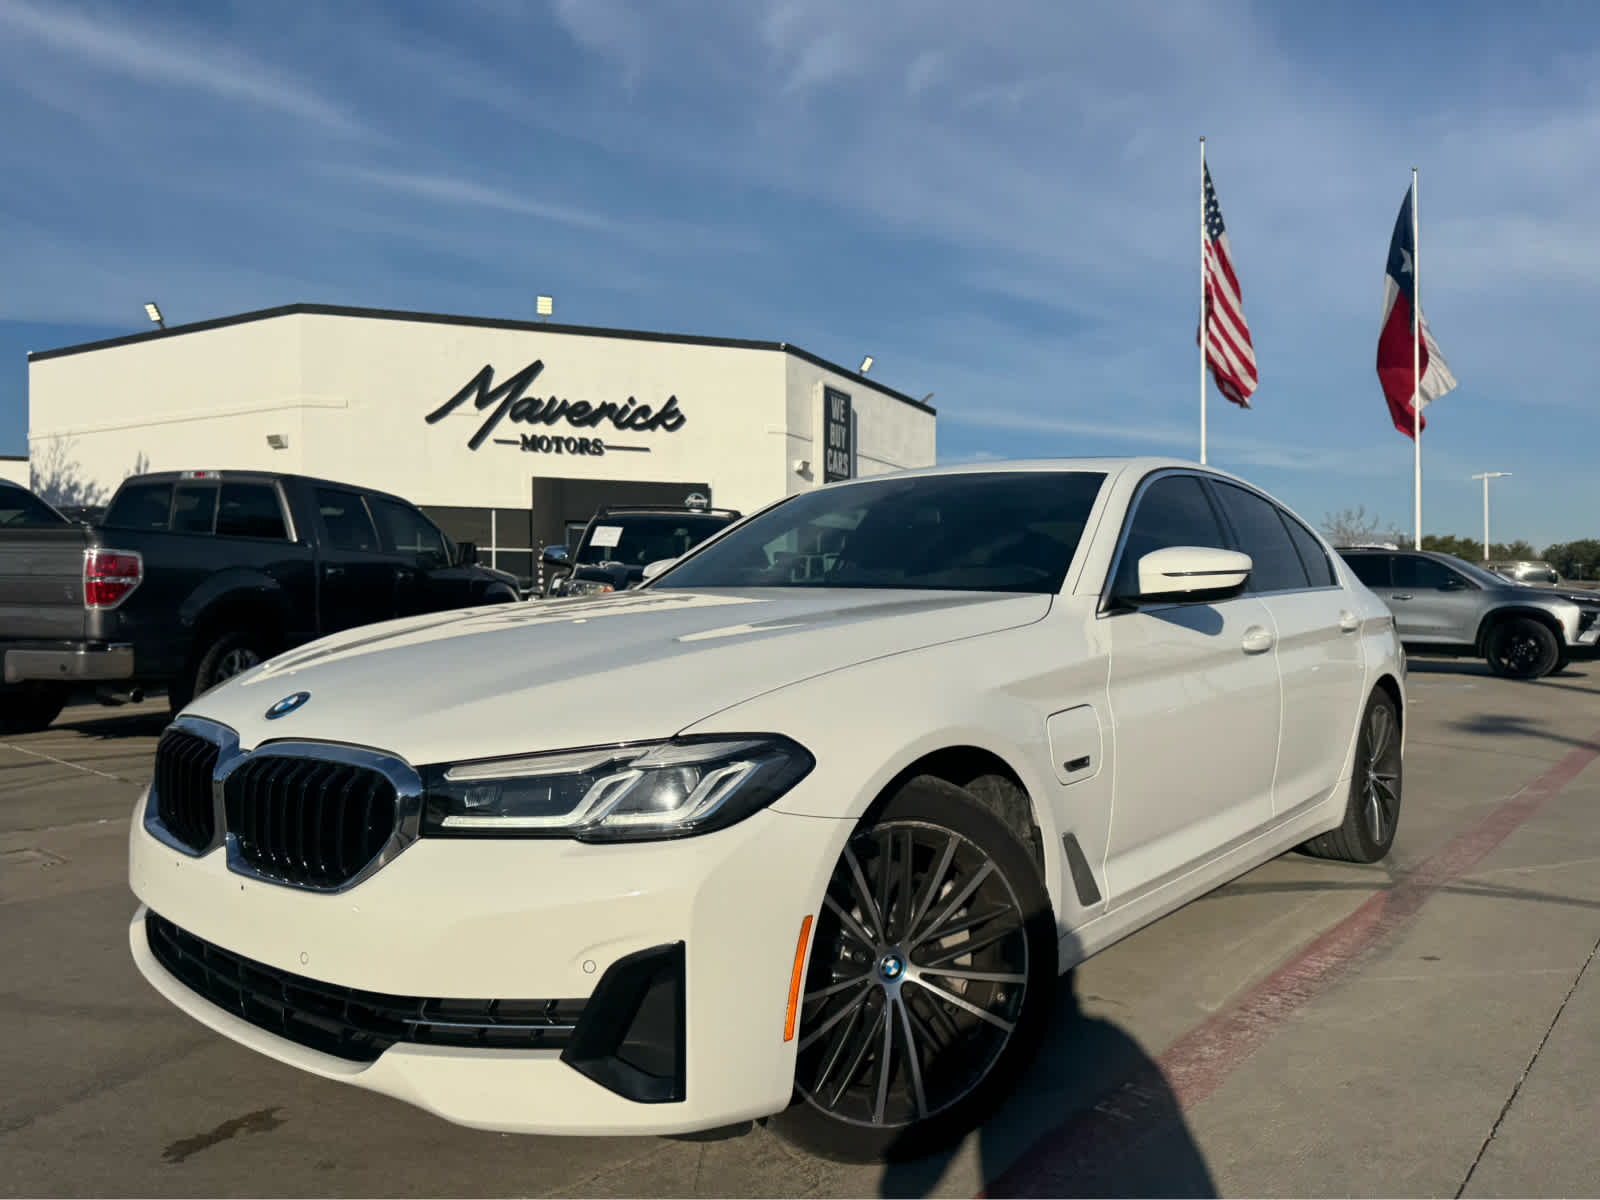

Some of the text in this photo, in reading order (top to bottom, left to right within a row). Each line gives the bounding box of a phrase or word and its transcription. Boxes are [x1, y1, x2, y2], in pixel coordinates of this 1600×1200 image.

[425, 359, 687, 451] Maverick
[831, 395, 846, 422] WE
[520, 433, 605, 456] MOTORS
[830, 422, 846, 450] BUY
[827, 448, 849, 476] CARS
